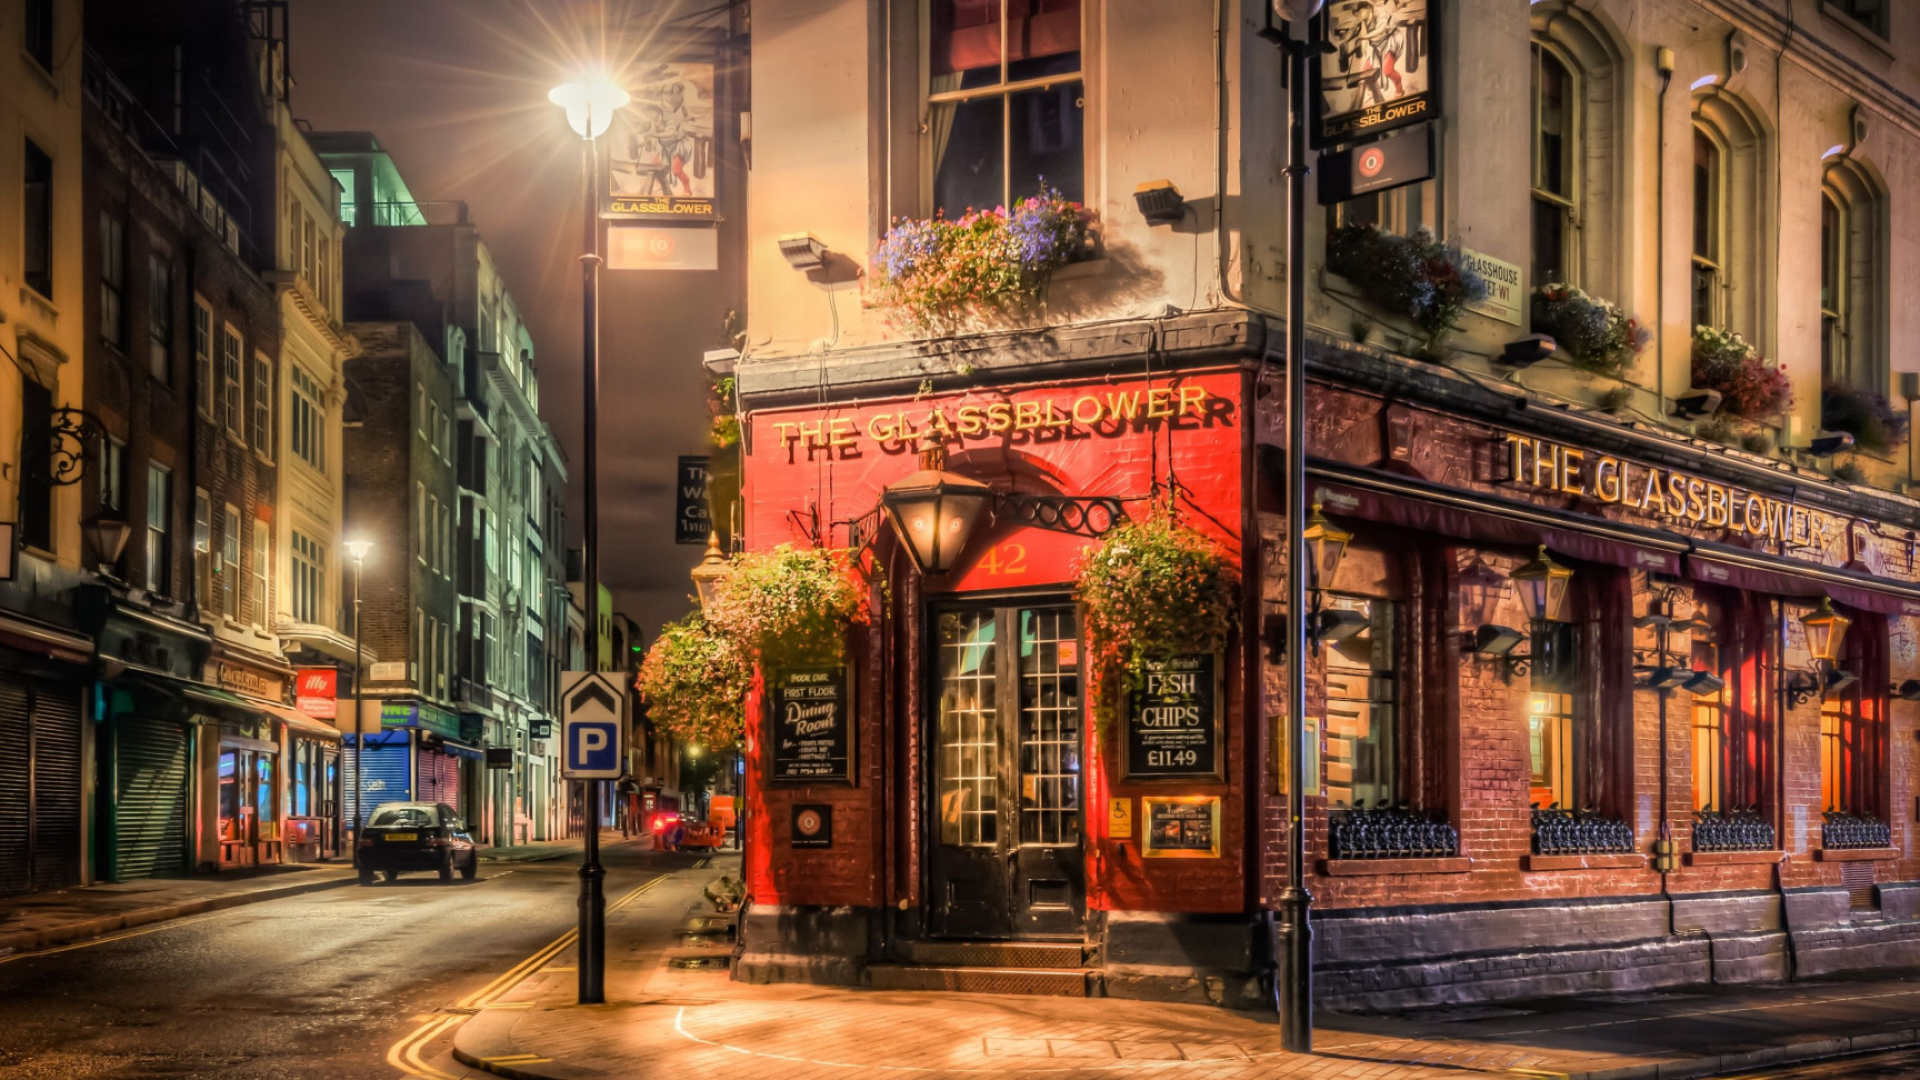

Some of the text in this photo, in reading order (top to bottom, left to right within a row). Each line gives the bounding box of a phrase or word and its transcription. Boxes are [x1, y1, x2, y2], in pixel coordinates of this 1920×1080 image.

[1323, 101, 1426, 138] GLASSBLOWER
[1366, 106, 1382, 115] THE
[611, 202, 712, 214] GLASSBLOWER
[1467, 254, 1518, 286] GLASSHOUSE
[773, 386, 1208, 448] THE GLASSBLOWER
[687, 467, 709, 480] Th
[1507, 433, 1827, 551] THE GLASSBLOWER
[976, 543, 1027, 575] 42
[305, 675, 328, 693] illy
[784, 687, 836, 698] FIRST FLOOR
[1147, 673, 1195, 694] FISH
[785, 701, 837, 724] Dining
[1142, 706, 1199, 727] CHIPS
[796, 717, 837, 736] Room
[579, 727, 608, 765] P
[1148, 750, 1197, 766] £11.49
